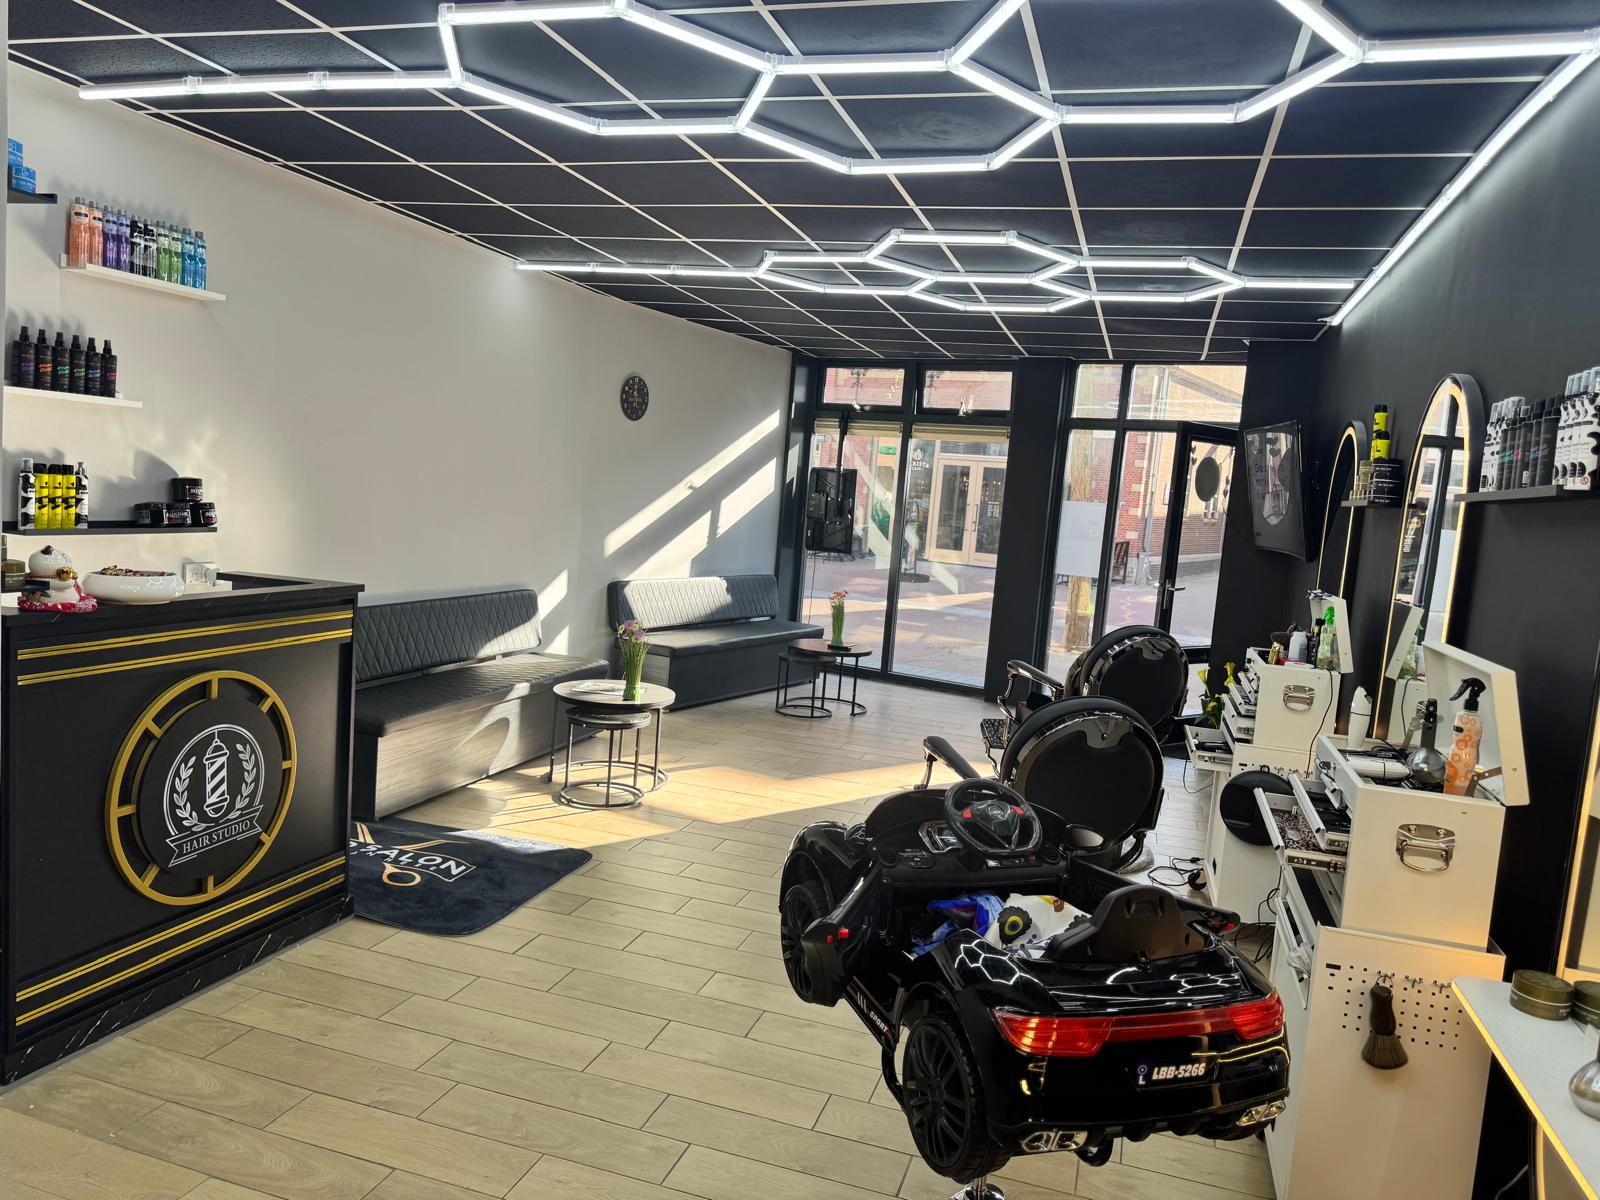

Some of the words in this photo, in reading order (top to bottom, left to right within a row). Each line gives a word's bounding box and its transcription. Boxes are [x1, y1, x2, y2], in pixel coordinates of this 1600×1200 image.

[182, 835, 210, 854] HAIR
[212, 820, 250, 843] STUDIO
[359, 844, 467, 876] SALON
[869, 1010, 889, 1033] SPORT
[1138, 1076, 1146, 1085] L
[1152, 1063, 1206, 1080] LBB-5266
